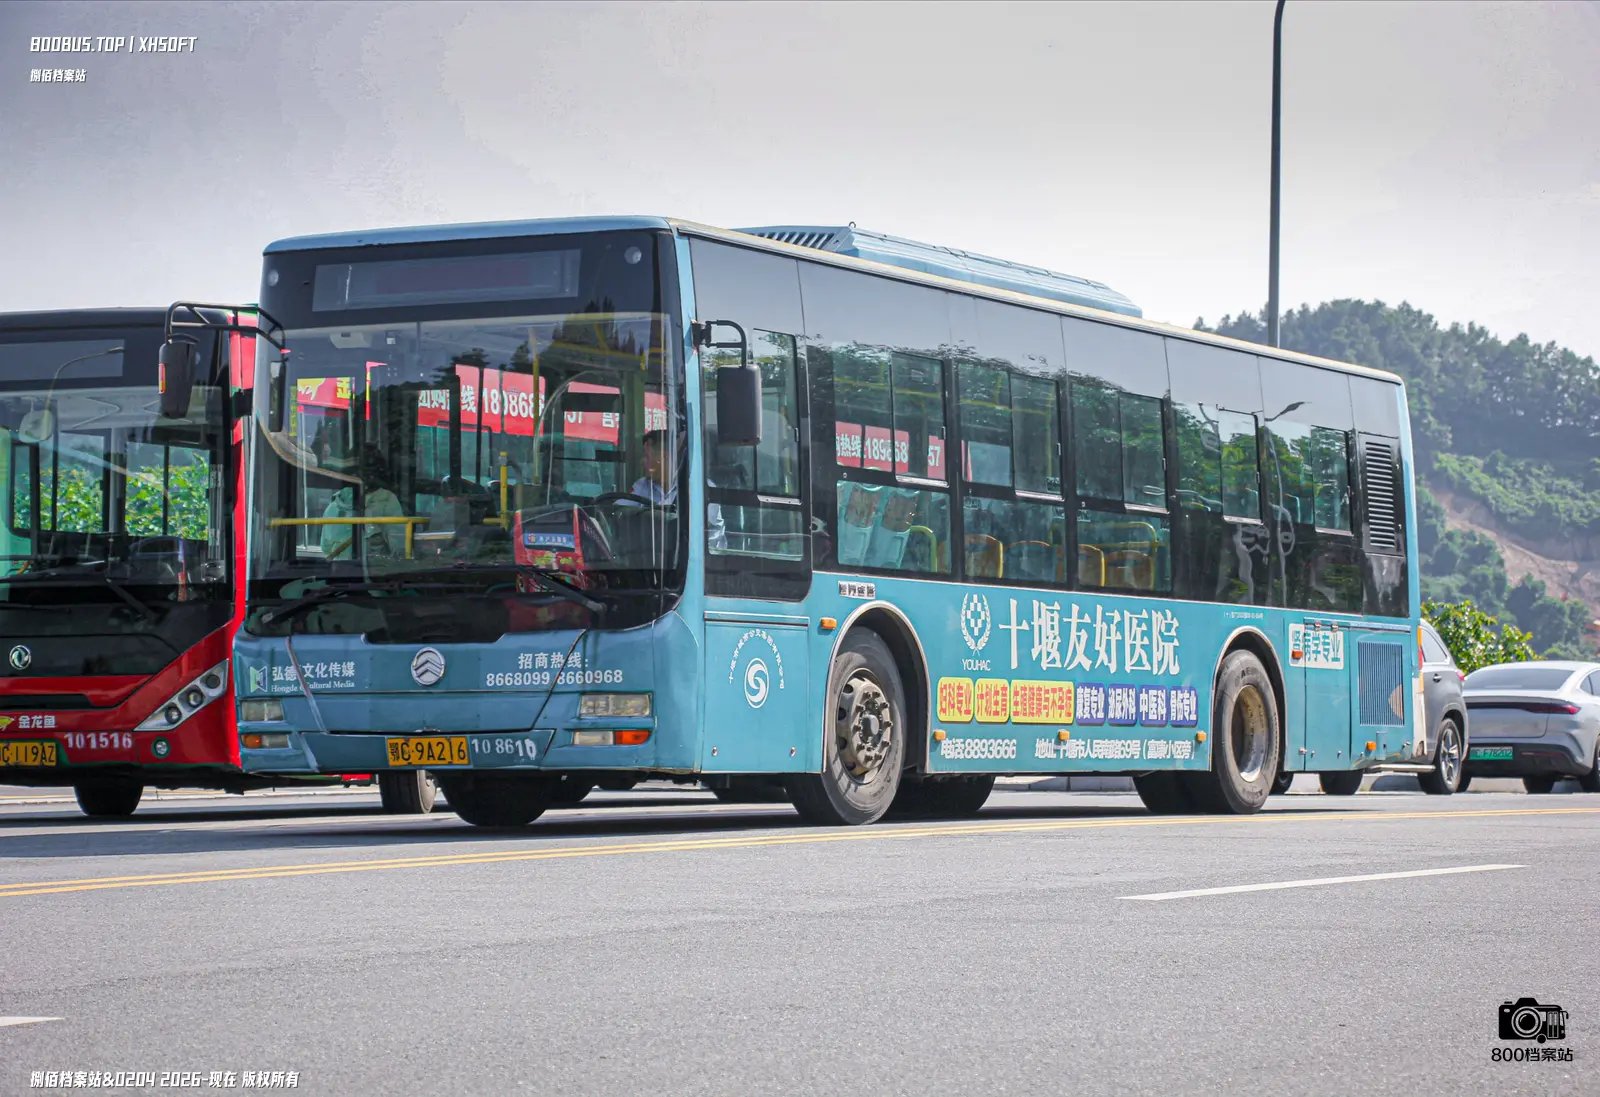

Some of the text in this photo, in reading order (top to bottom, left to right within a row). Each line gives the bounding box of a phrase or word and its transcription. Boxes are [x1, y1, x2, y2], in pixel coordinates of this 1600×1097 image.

[998, 598, 1180, 675] 十堰友好医院
[271, 661, 355, 681] 弘德文化传媒
[962, 658, 991, 671] YOUHAC
[486, 669, 623, 686] 8668099 8660968
[271, 684, 298, 693] Hongde
[333, 680, 355, 689] Media
[939, 682, 972, 716] 妇科专业
[976, 683, 1008, 716] 计划生育
[1076, 686, 1105, 719] 康复专业
[1107, 687, 1136, 720] 泌尿外科
[1139, 688, 1167, 720] 中医科
[18, 714, 56, 729] 金龙鱼
[64, 732, 132, 748] 101516
